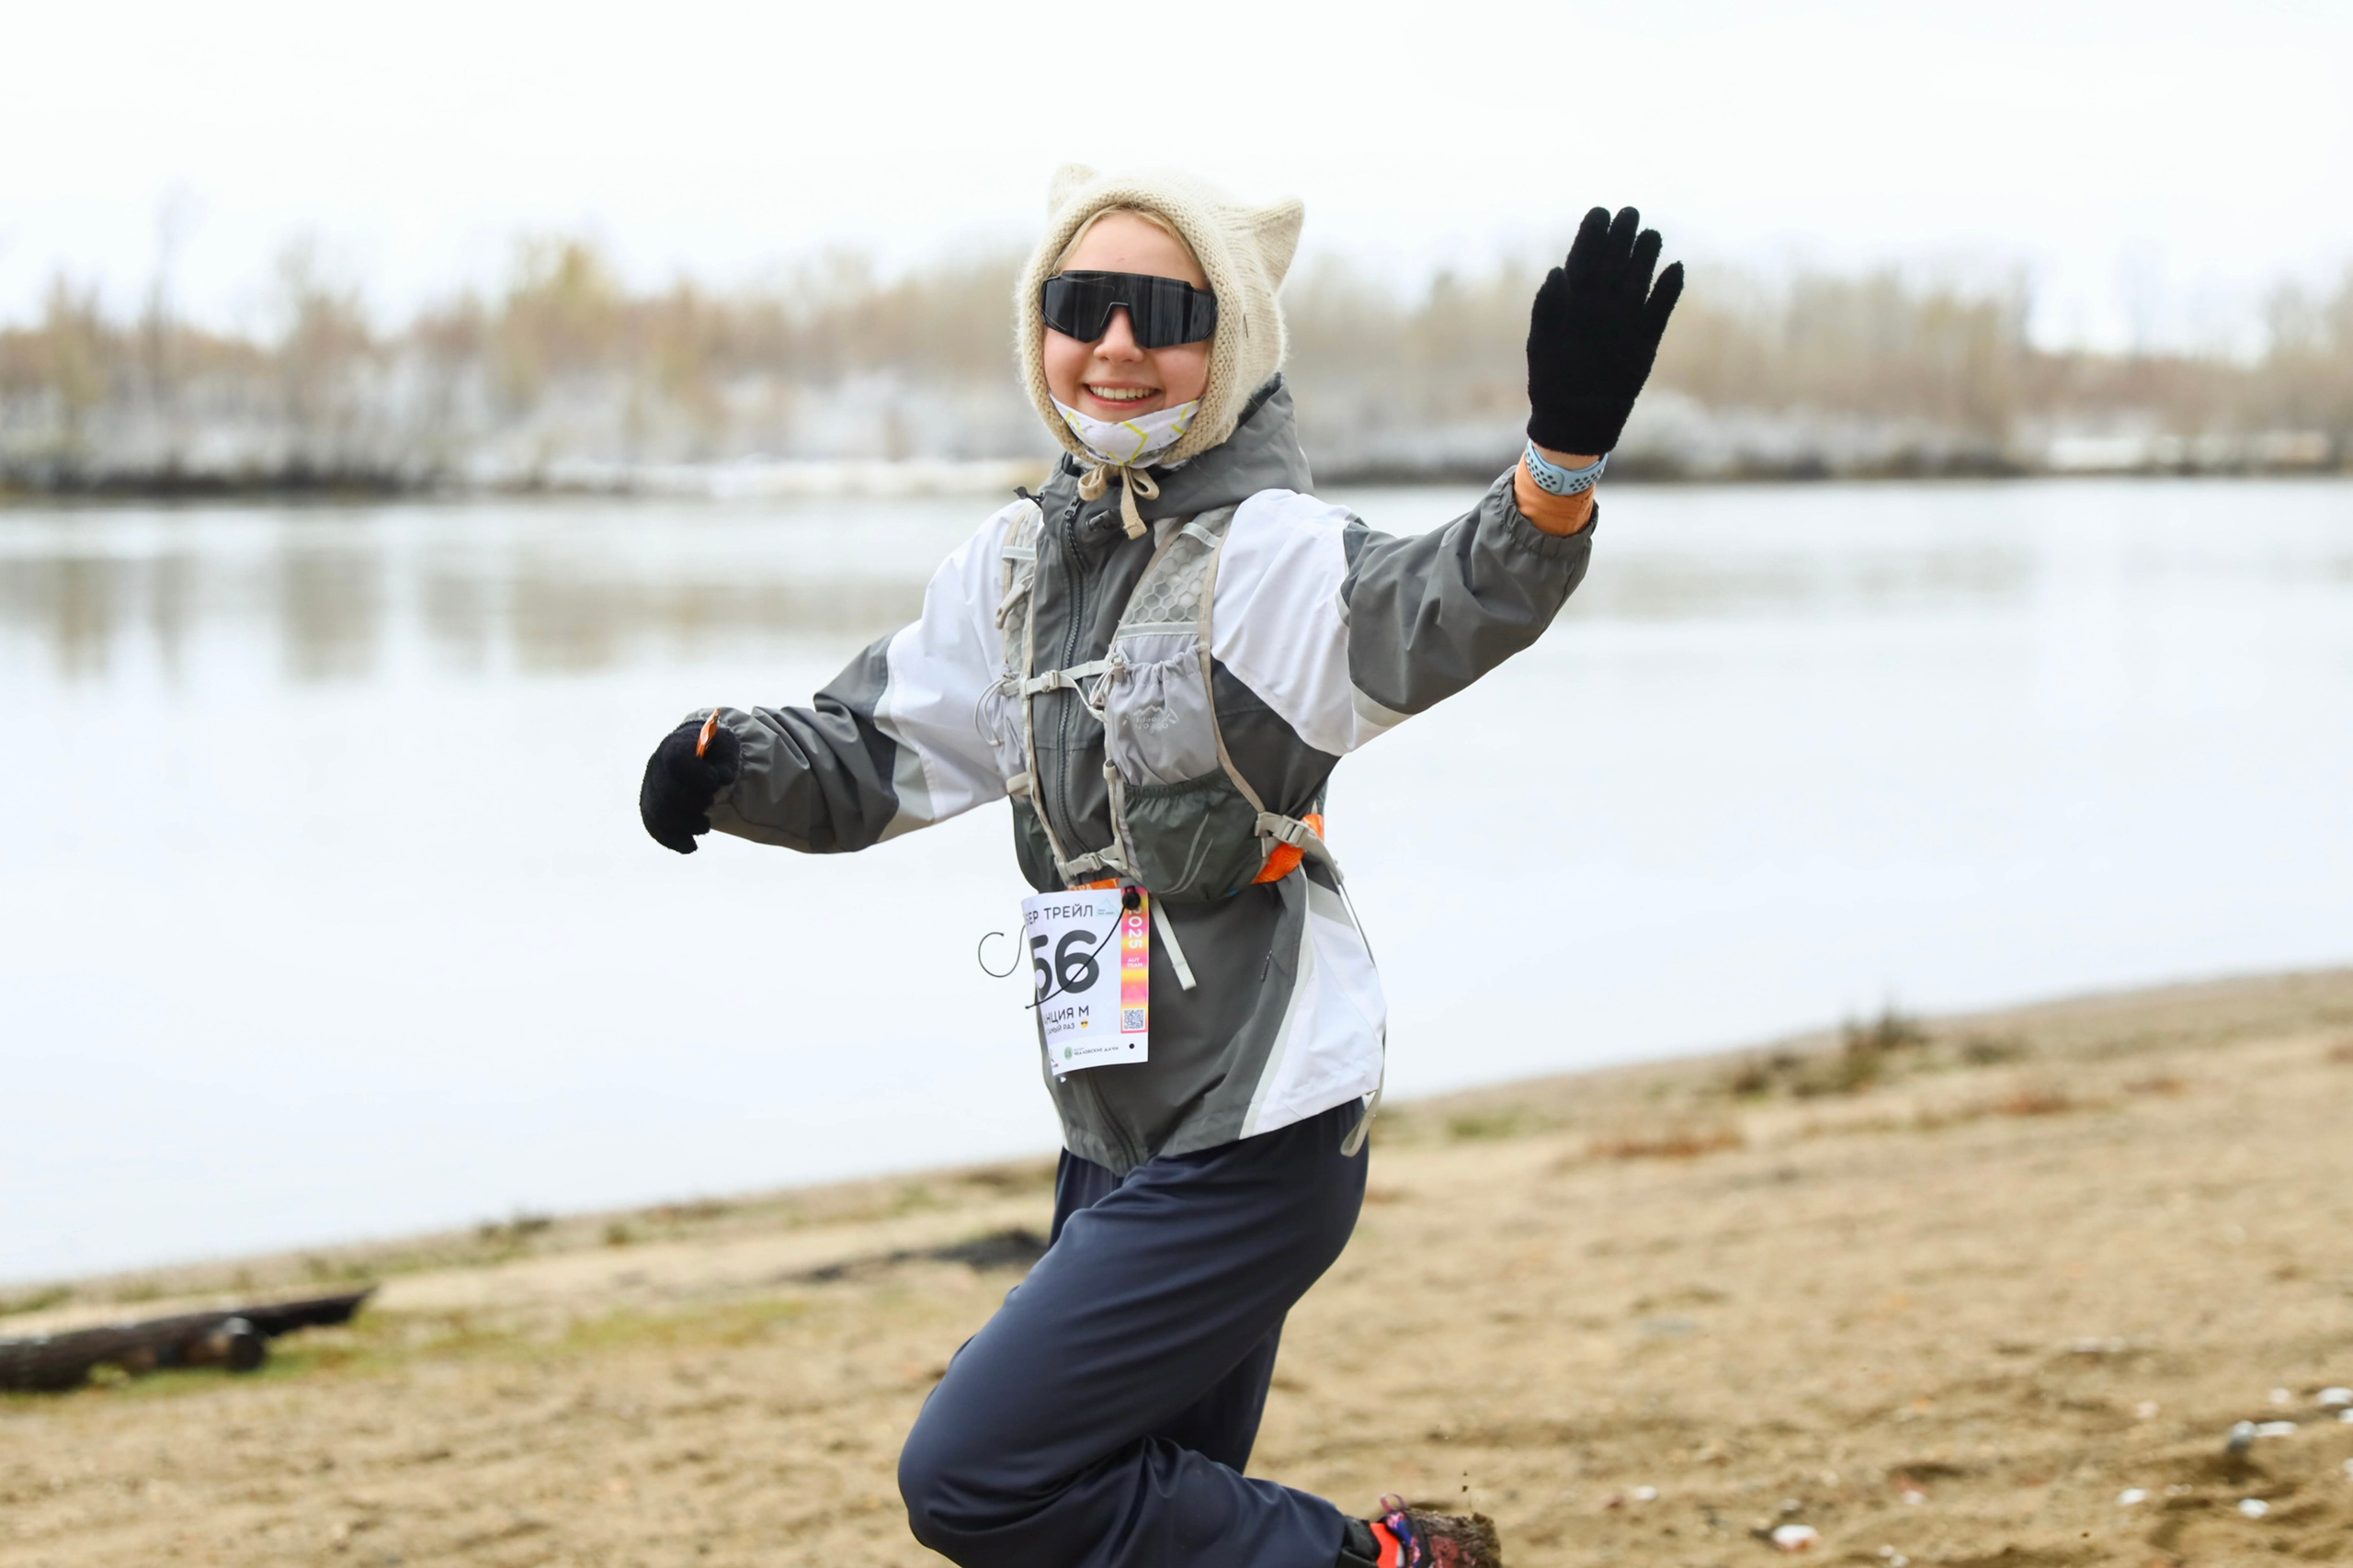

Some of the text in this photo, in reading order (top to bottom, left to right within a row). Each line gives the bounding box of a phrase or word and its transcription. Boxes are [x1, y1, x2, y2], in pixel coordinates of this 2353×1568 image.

[1043, 903, 1094, 920] ТРЕЙЛ
[1128, 905, 1143, 949] 2025
[1030, 929, 1100, 1001] 56
